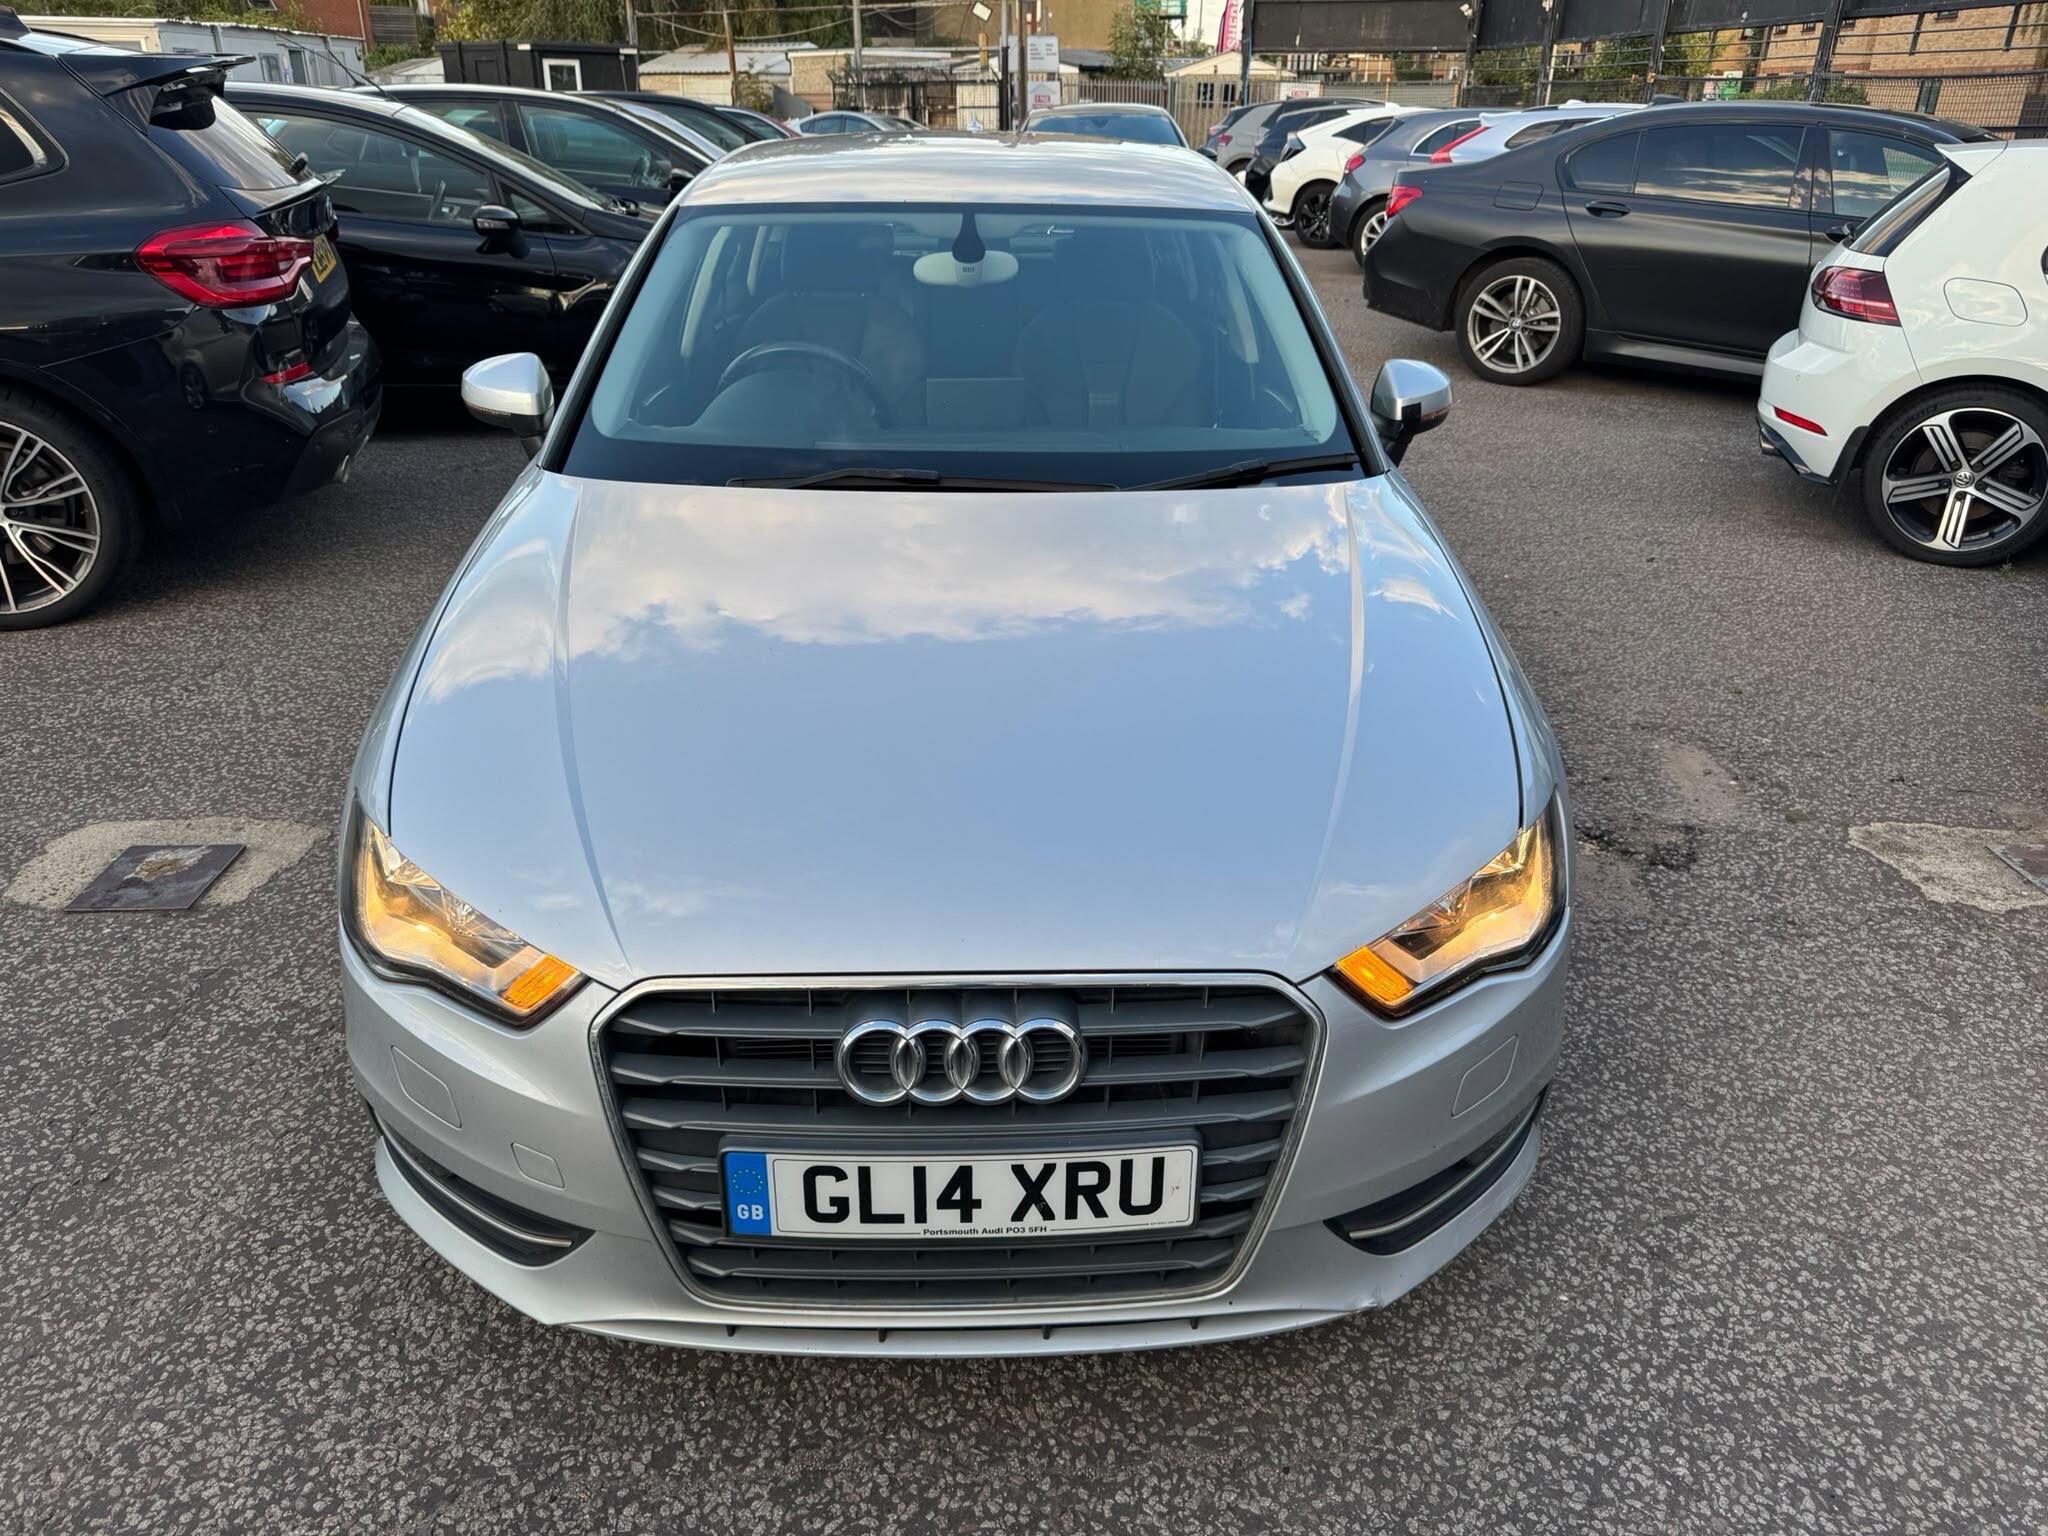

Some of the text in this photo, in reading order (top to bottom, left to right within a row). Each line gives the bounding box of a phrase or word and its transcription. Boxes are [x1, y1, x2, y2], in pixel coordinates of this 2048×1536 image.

[803, 1156, 1165, 1224] GL14 XRU
[736, 1203, 764, 1221] GB
[923, 1225, 1047, 1236] Portsmouth Audi PO3 5FH
